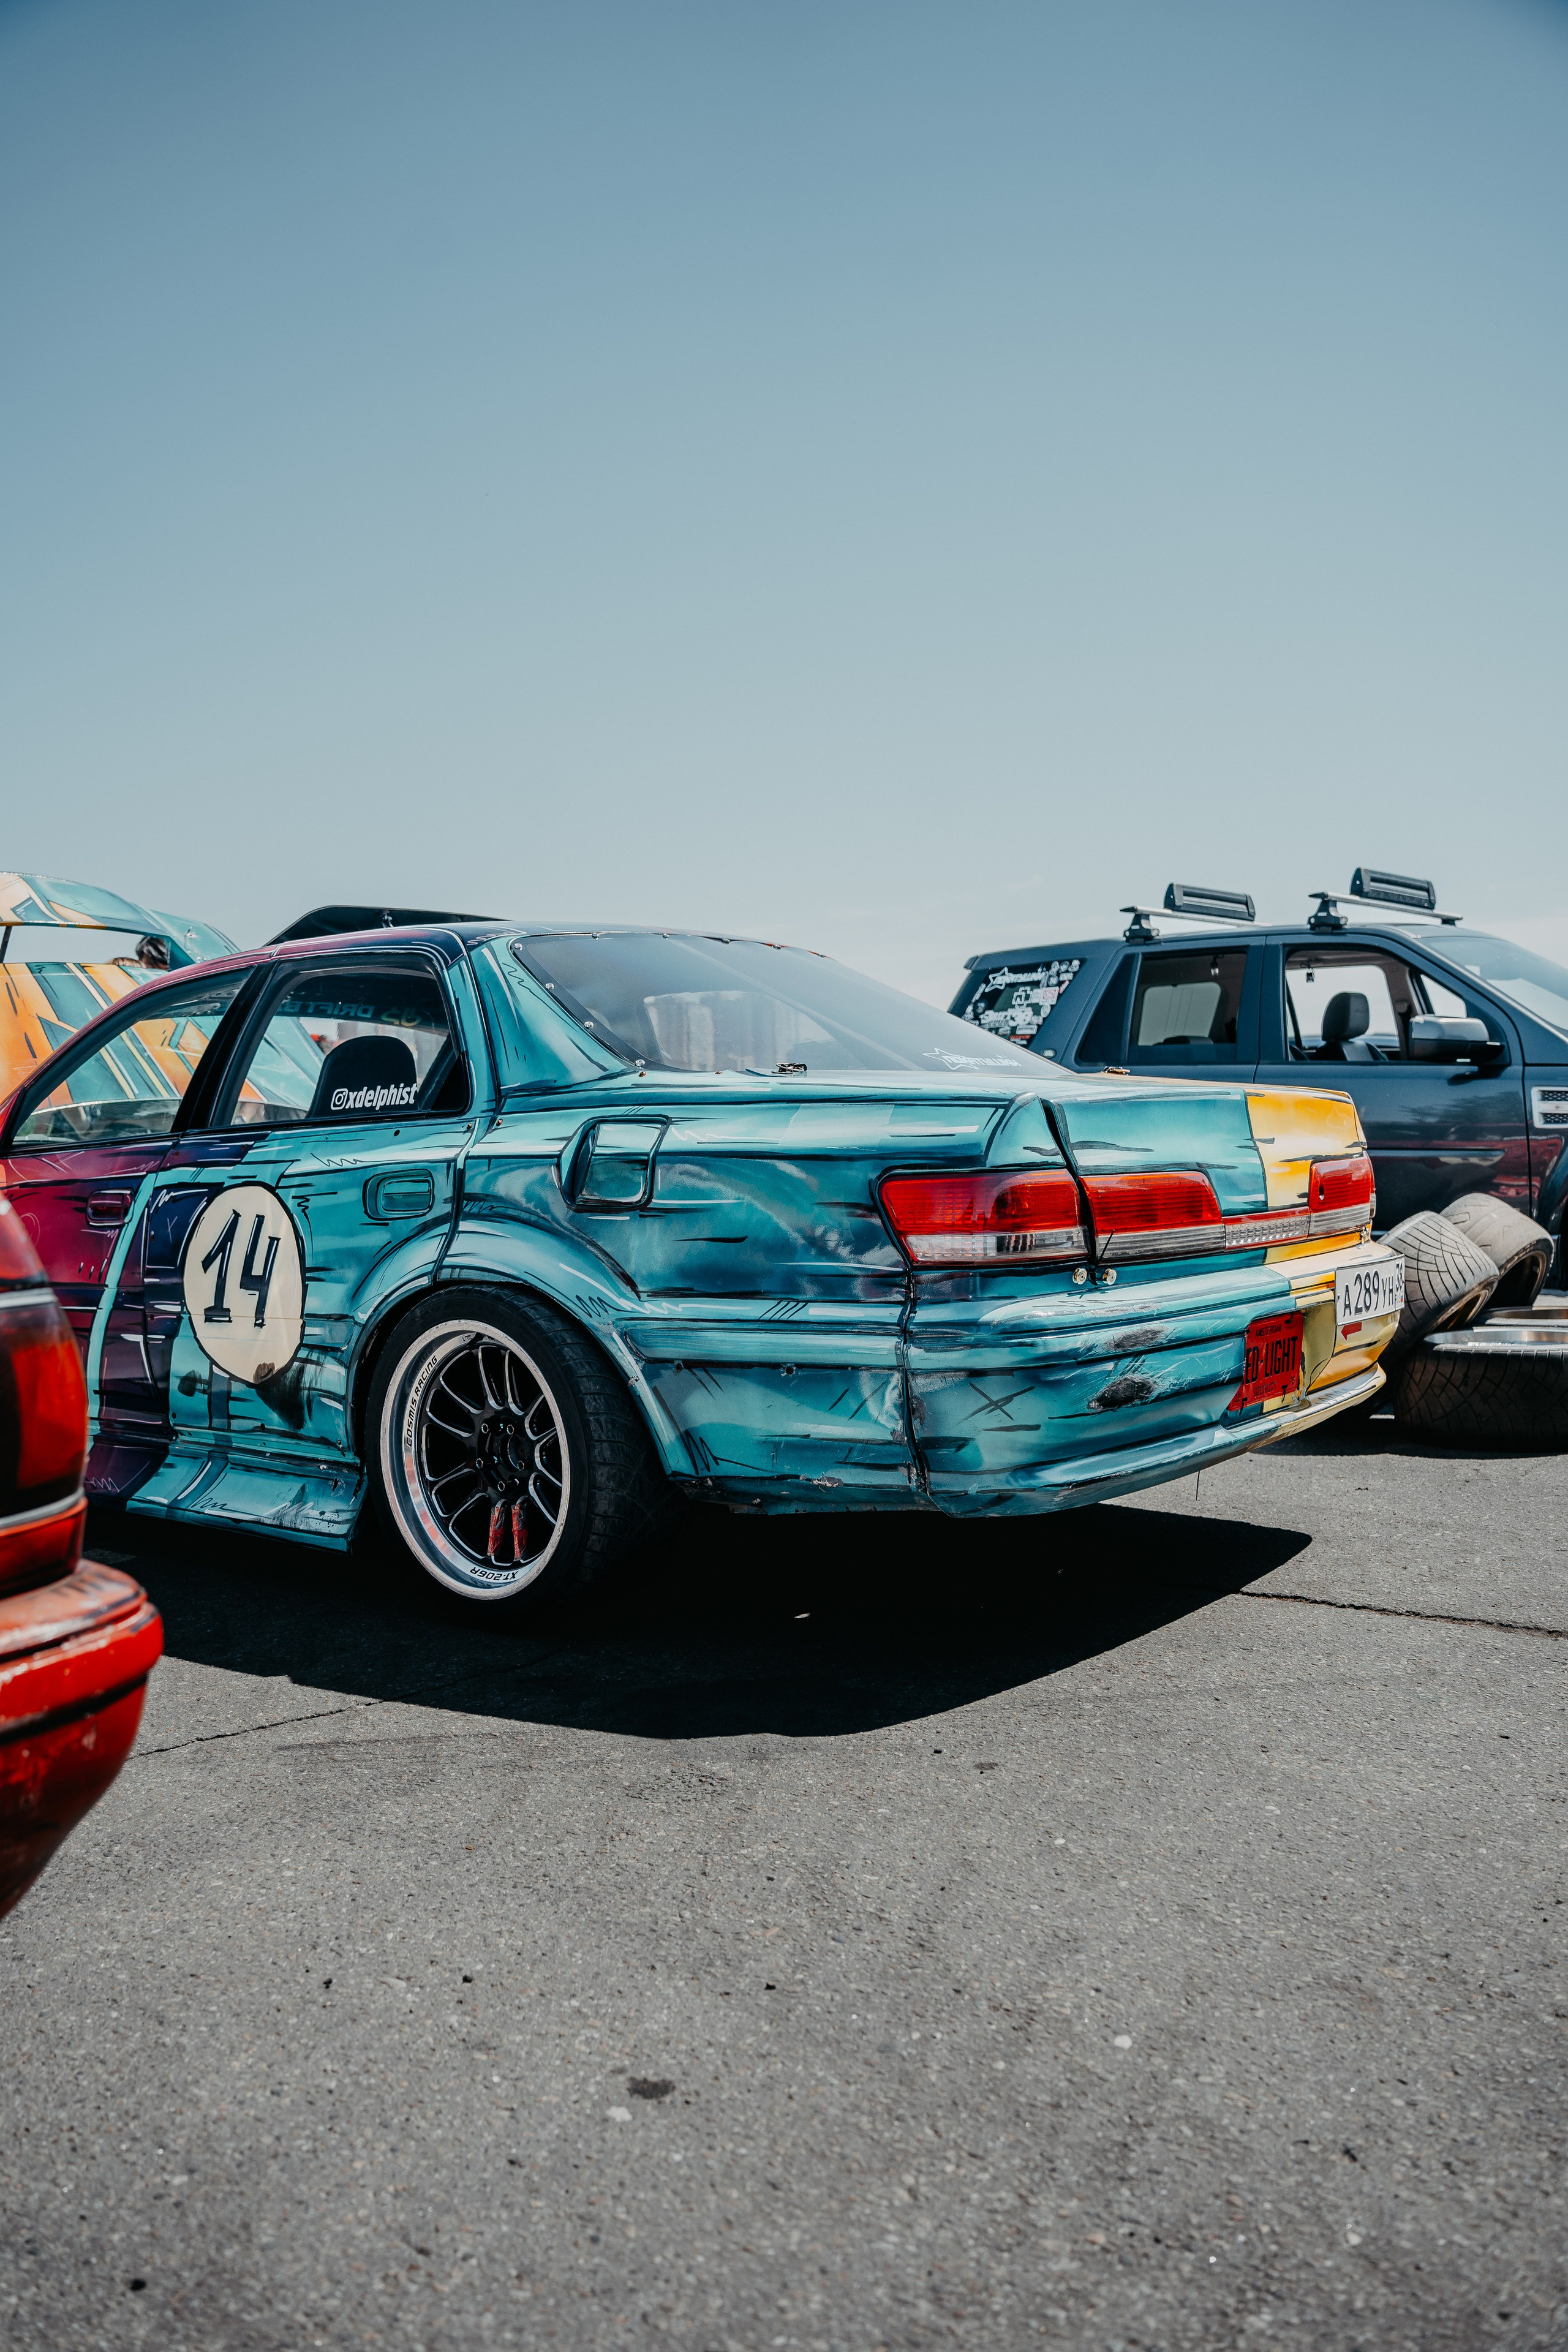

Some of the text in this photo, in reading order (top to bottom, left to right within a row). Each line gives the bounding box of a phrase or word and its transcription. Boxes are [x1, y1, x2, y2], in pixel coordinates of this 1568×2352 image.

[345, 1083, 418, 1110] xdelphist
[202, 1208, 281, 1329] 14
[1255, 1324, 1282, 1338] AMSTERDAM
[1242, 1336, 1298, 1385] ED-LIGHT
[407, 1355, 437, 1447] COSMIS RACING
[1254, 1381, 1277, 1396] DISTRICT
[470, 1567, 519, 1580] XT-206R
